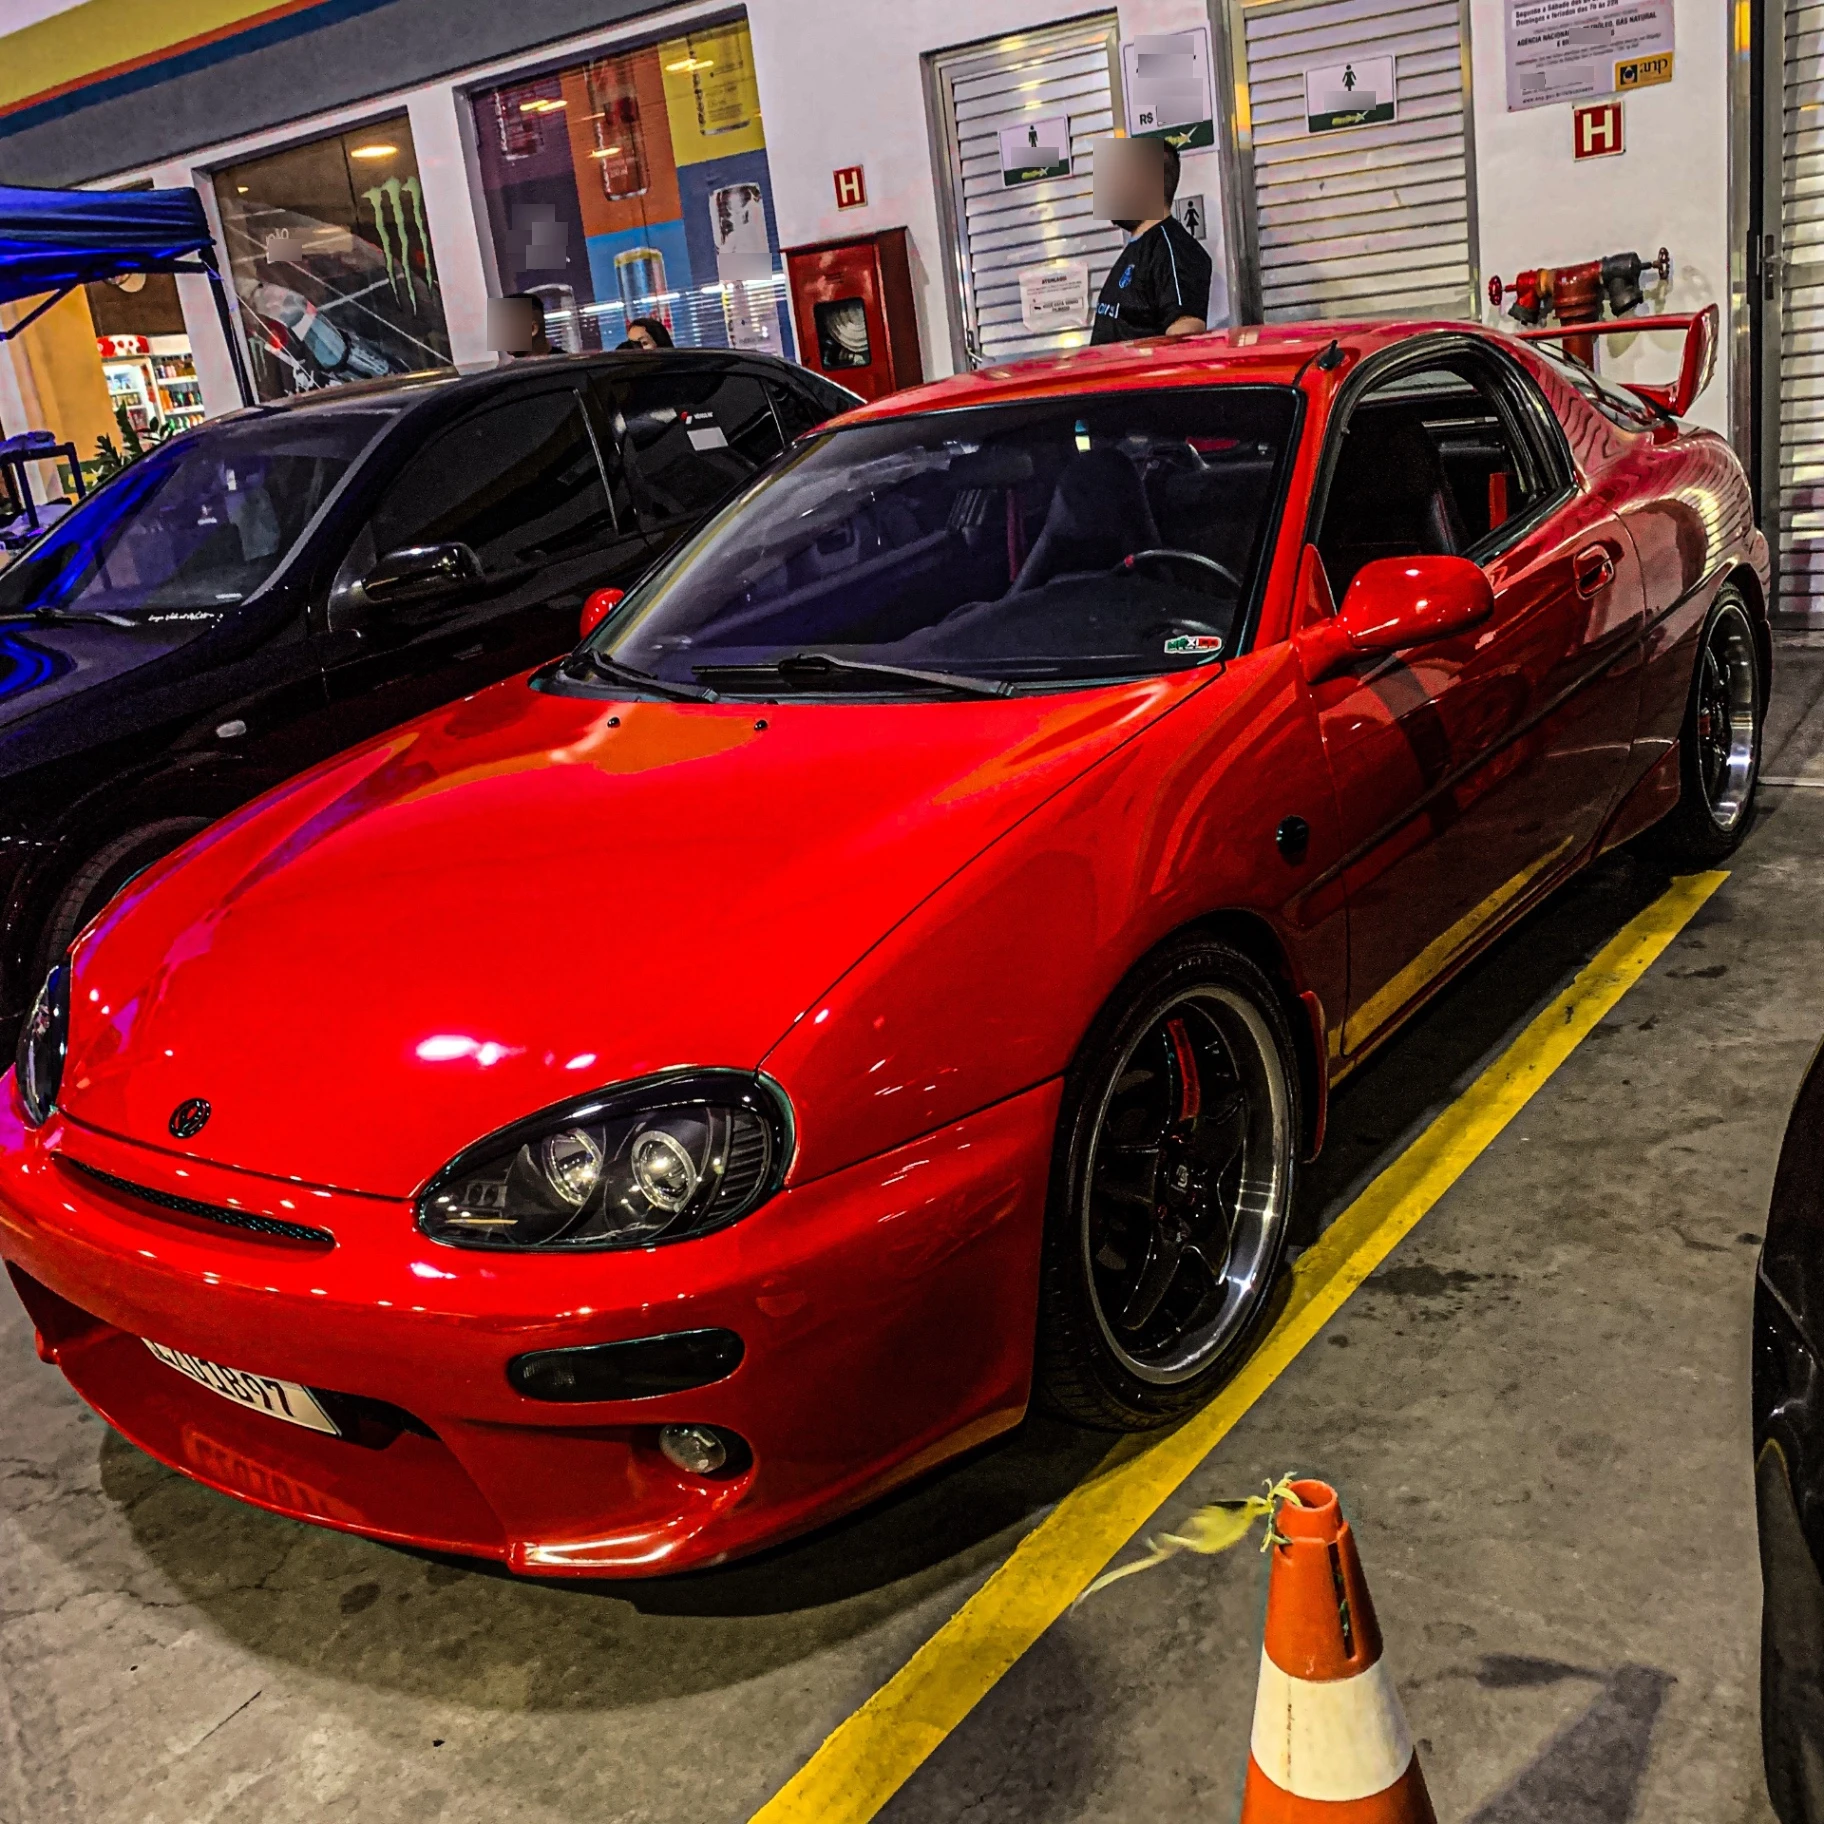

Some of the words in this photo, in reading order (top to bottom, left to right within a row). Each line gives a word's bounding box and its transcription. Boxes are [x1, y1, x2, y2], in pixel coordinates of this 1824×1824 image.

[1640, 58, 1668, 74] anp
[1139, 112, 1154, 126] R$
[1583, 109, 1614, 152] H
[839, 170, 861, 204] H
